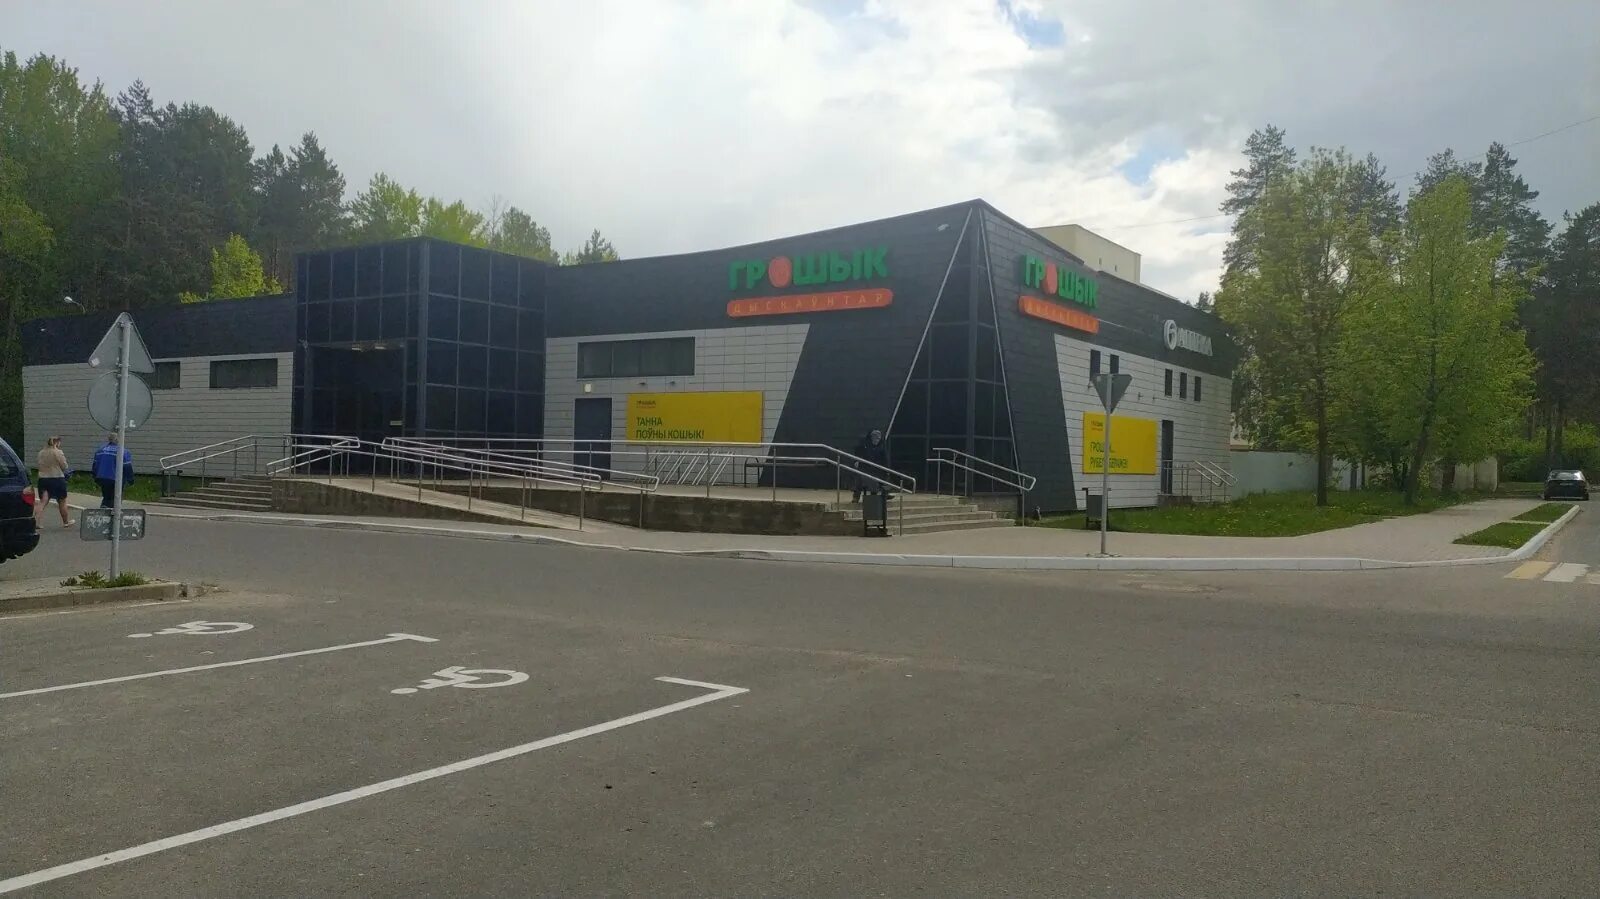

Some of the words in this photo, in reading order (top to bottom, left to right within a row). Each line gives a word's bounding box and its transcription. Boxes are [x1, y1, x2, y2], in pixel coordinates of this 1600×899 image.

[729, 246, 889, 290] ГРОШЫК
[1024, 254, 1099, 307] ГРОШЫК
[636, 416, 663, 426] ТАННА
[636, 427, 666, 439] ПОЎНЫ
[668, 429, 705, 439] КОШЫК!
